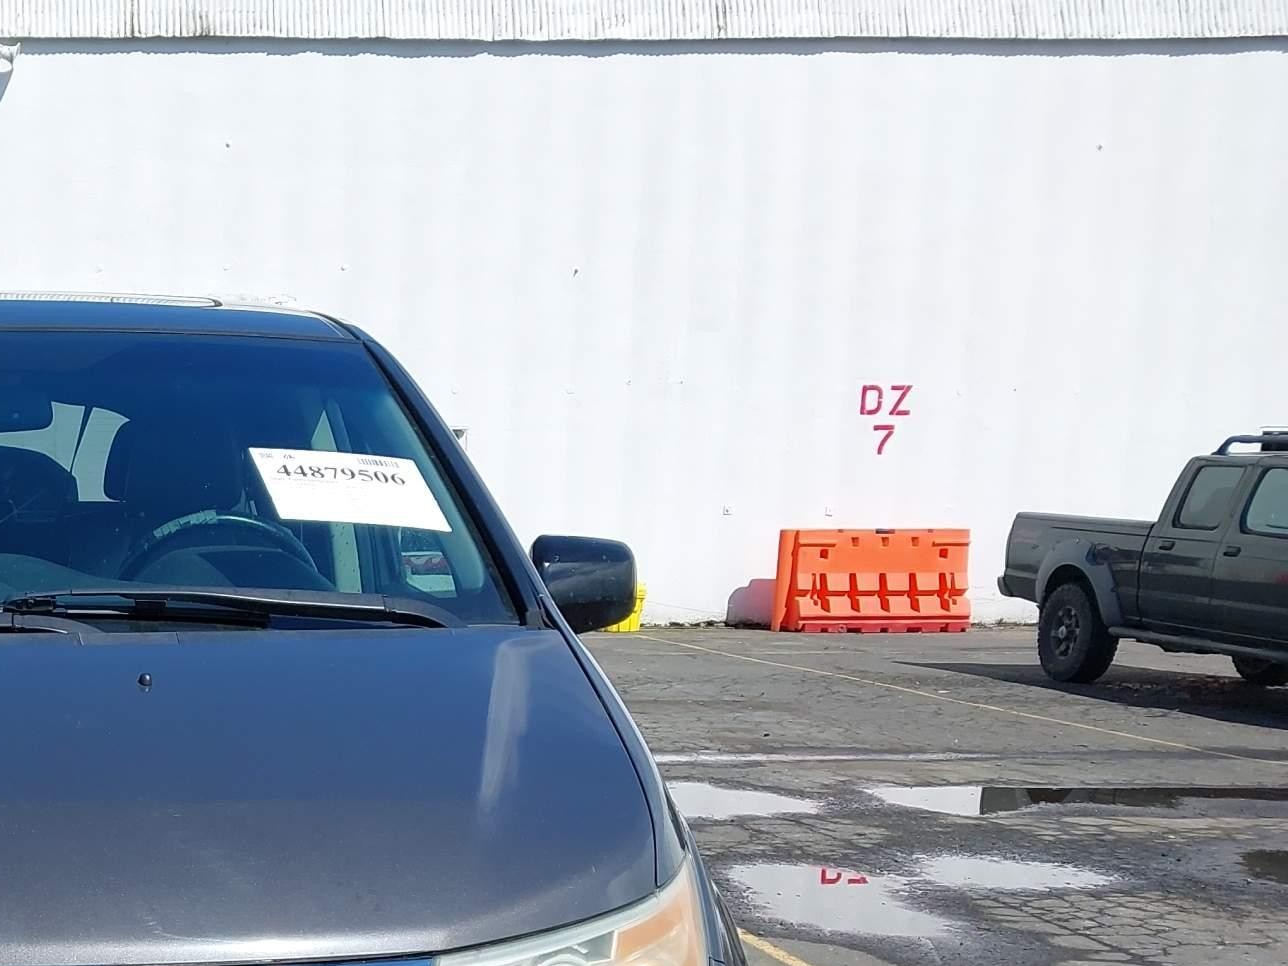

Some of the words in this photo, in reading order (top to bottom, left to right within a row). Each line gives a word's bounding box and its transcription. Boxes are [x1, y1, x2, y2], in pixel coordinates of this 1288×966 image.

[859, 384, 914, 416] DZ
[873, 424, 895, 455] 7
[276, 463, 407, 487] 44879506
